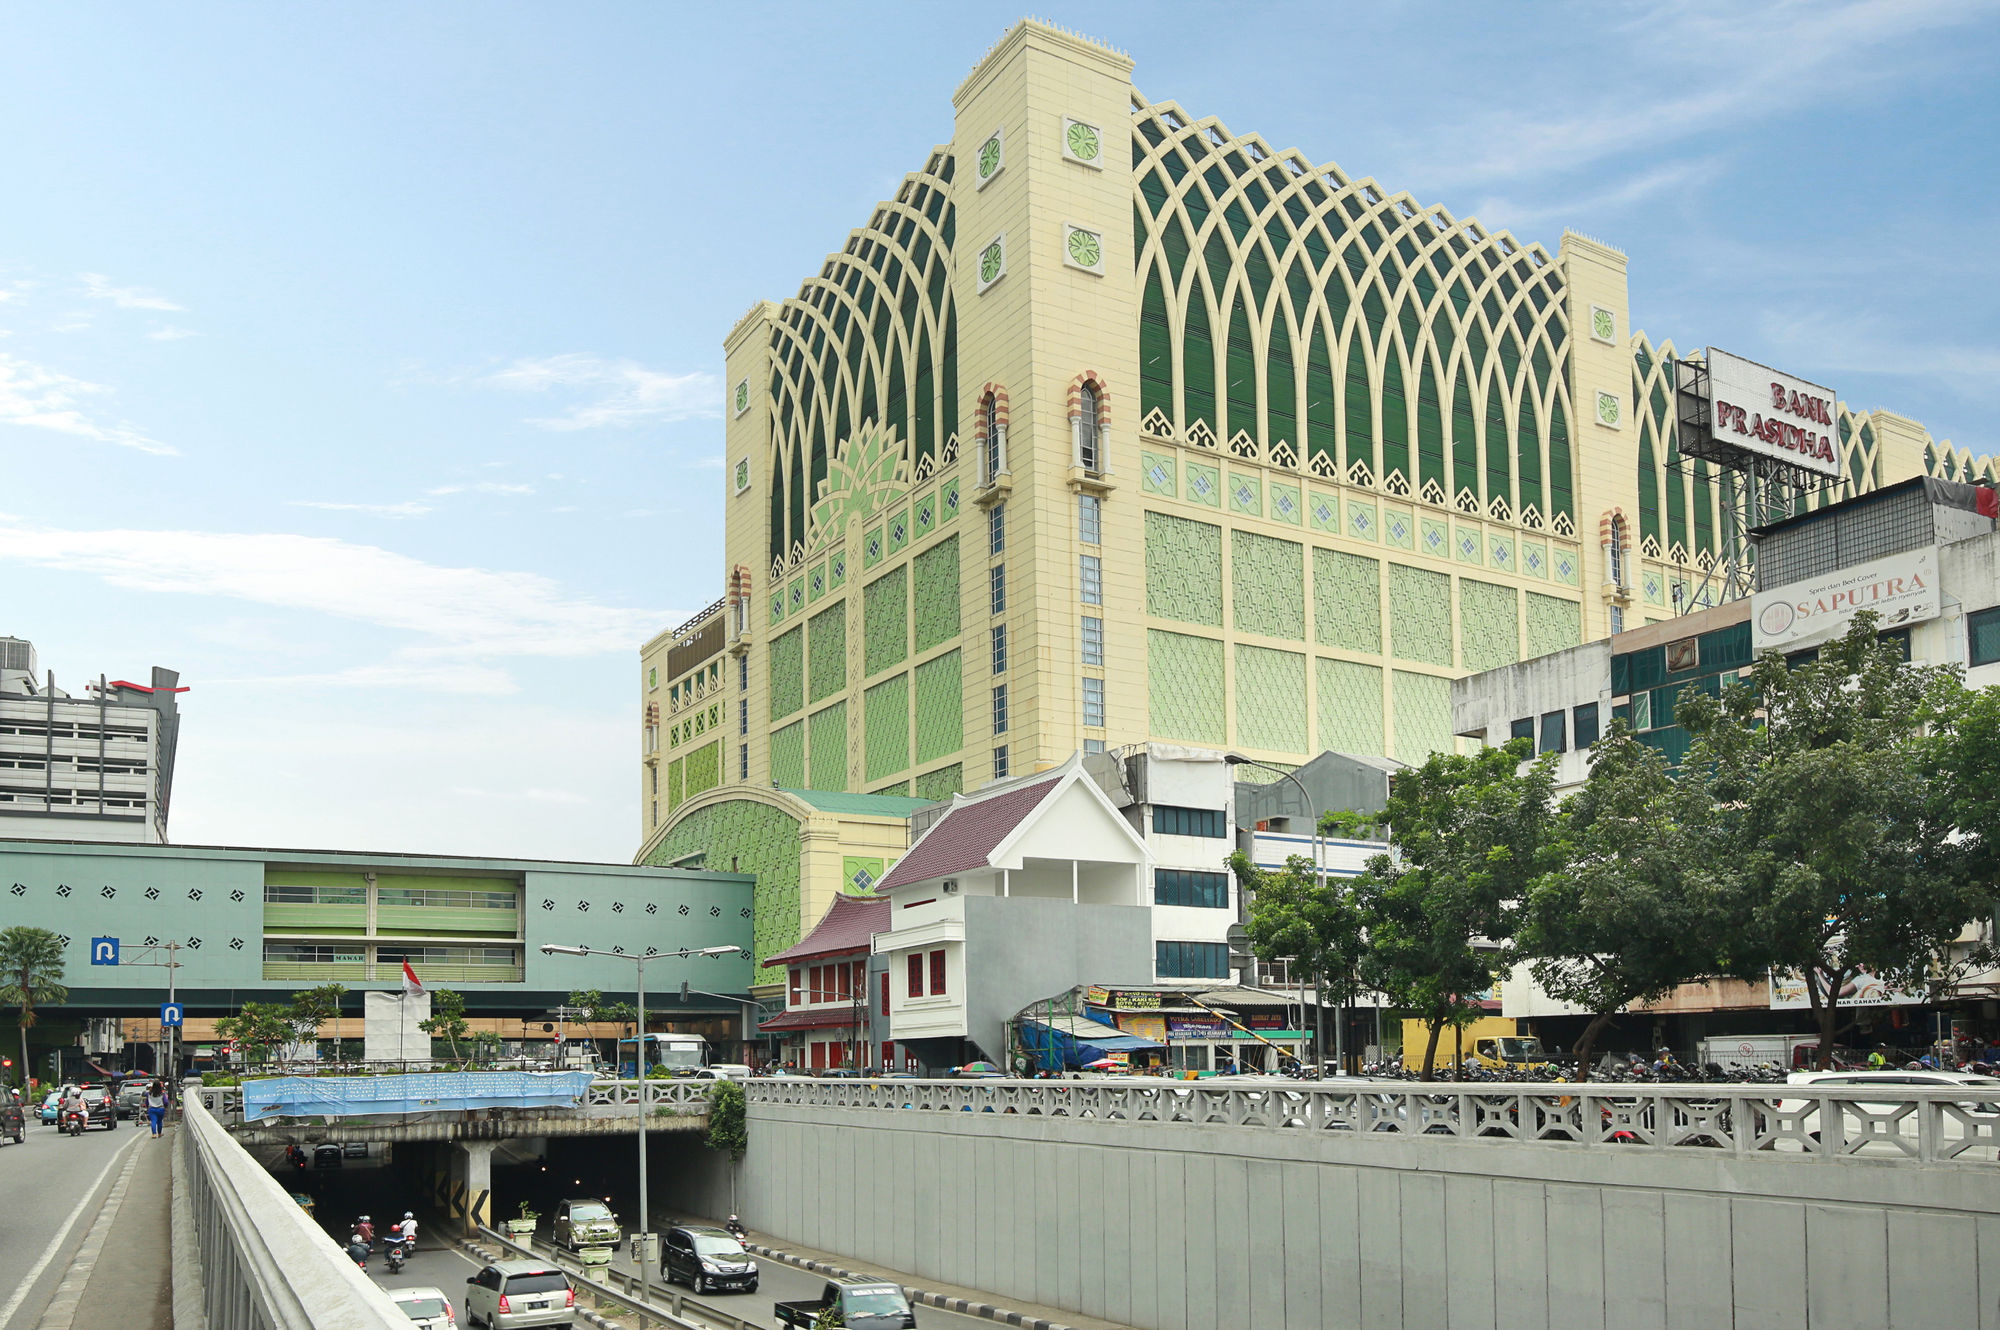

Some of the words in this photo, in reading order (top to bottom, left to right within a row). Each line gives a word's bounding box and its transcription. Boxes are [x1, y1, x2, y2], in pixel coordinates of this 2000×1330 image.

[1771, 382, 1832, 425] BANK
[1717, 400, 1835, 463] PRASIDHA
[1796, 573, 1927, 620] SAPUTRA
[1828, 583, 1840, 591] dan
[1842, 577, 1856, 586] Bed
[1857, 572, 1877, 582] Cover
